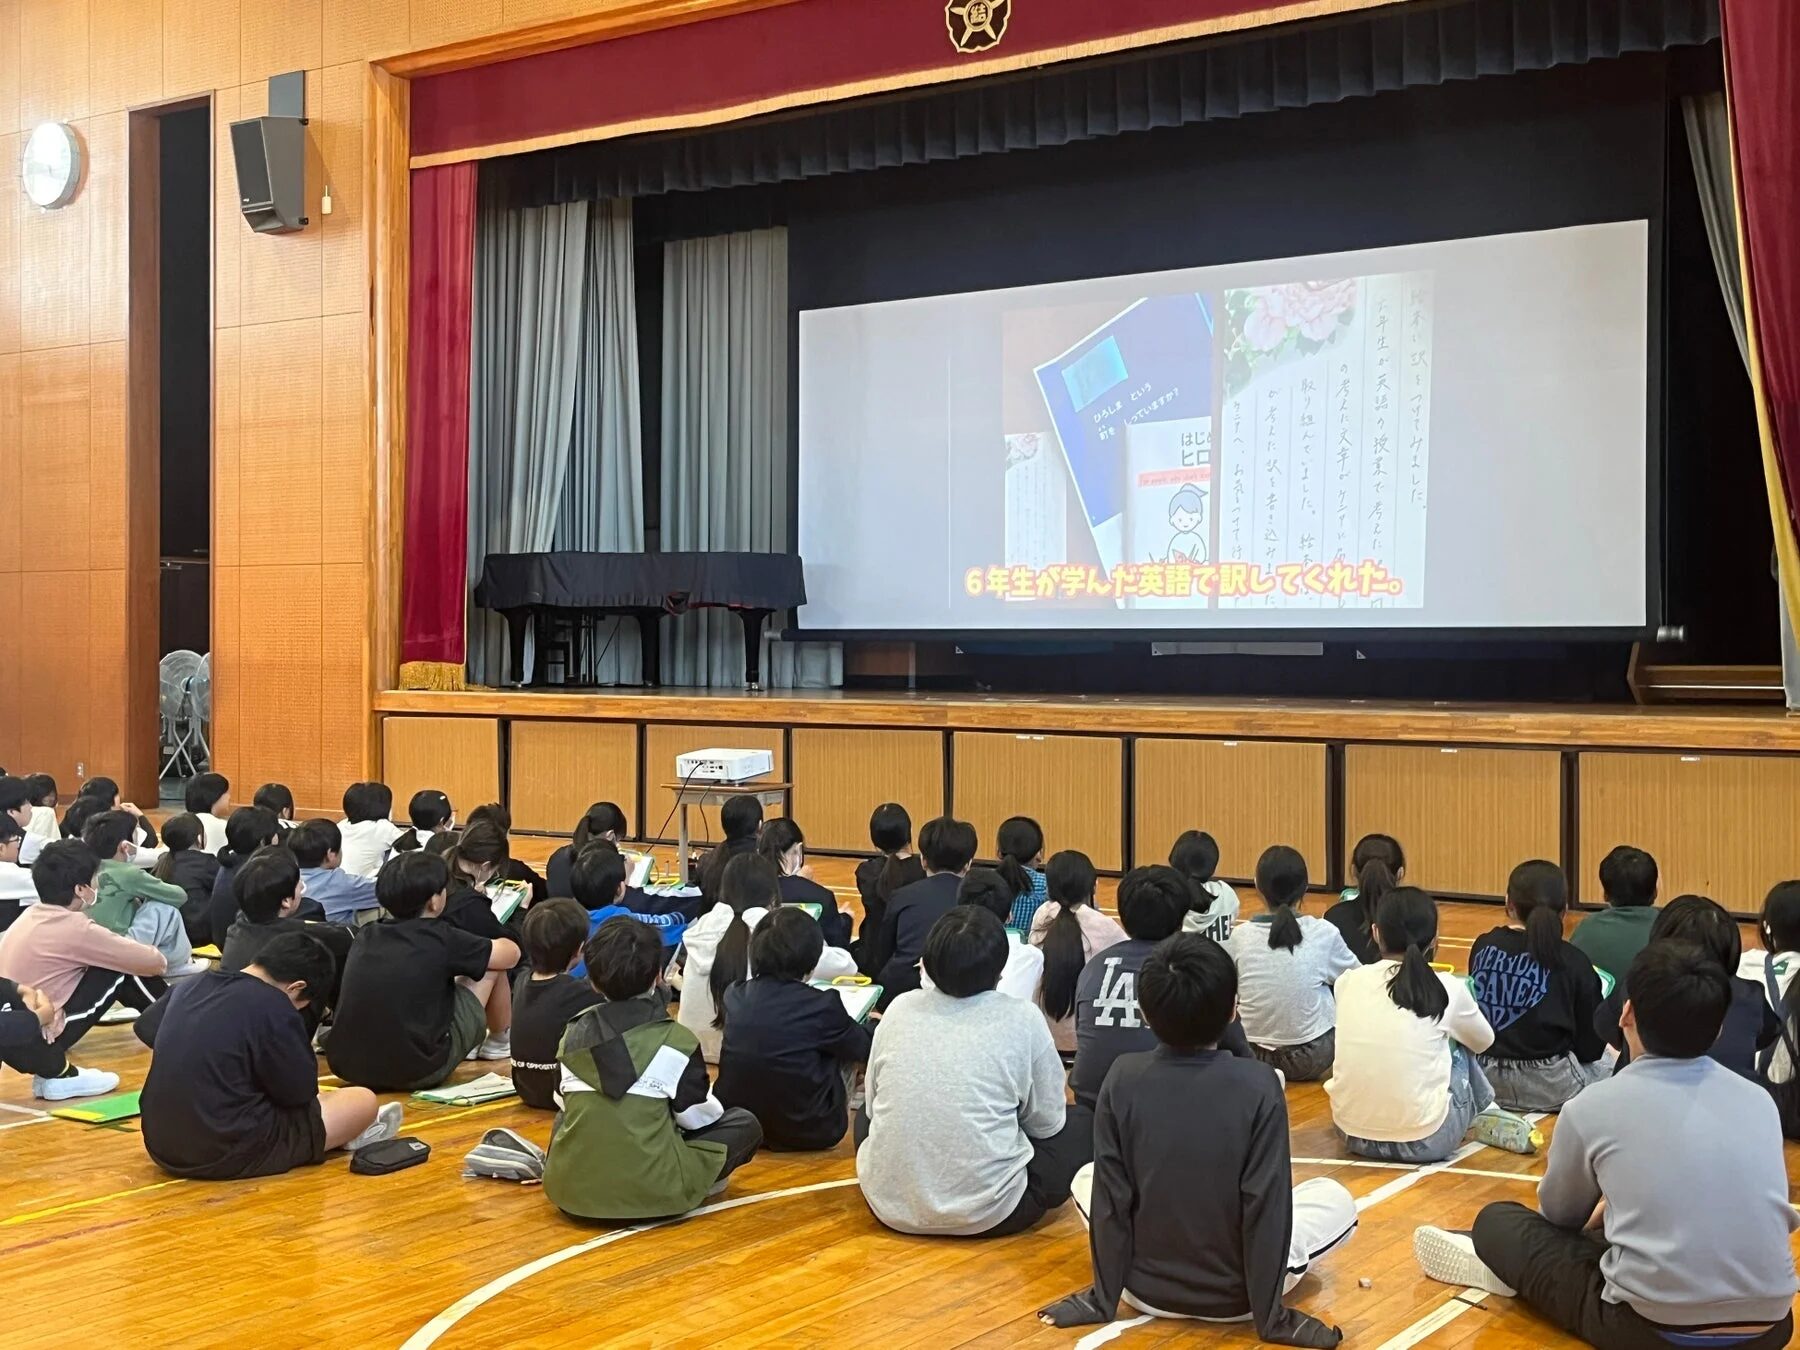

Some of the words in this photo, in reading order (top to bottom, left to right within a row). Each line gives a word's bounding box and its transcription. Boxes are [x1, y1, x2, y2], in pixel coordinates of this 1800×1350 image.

[1093, 400, 1123, 424] ひろしま
[1130, 381, 1152, 401] という
[965, 562, 1404, 597] 6年生が学んだ英語で訳してくれた。
[1093, 957, 1141, 1028] LA
